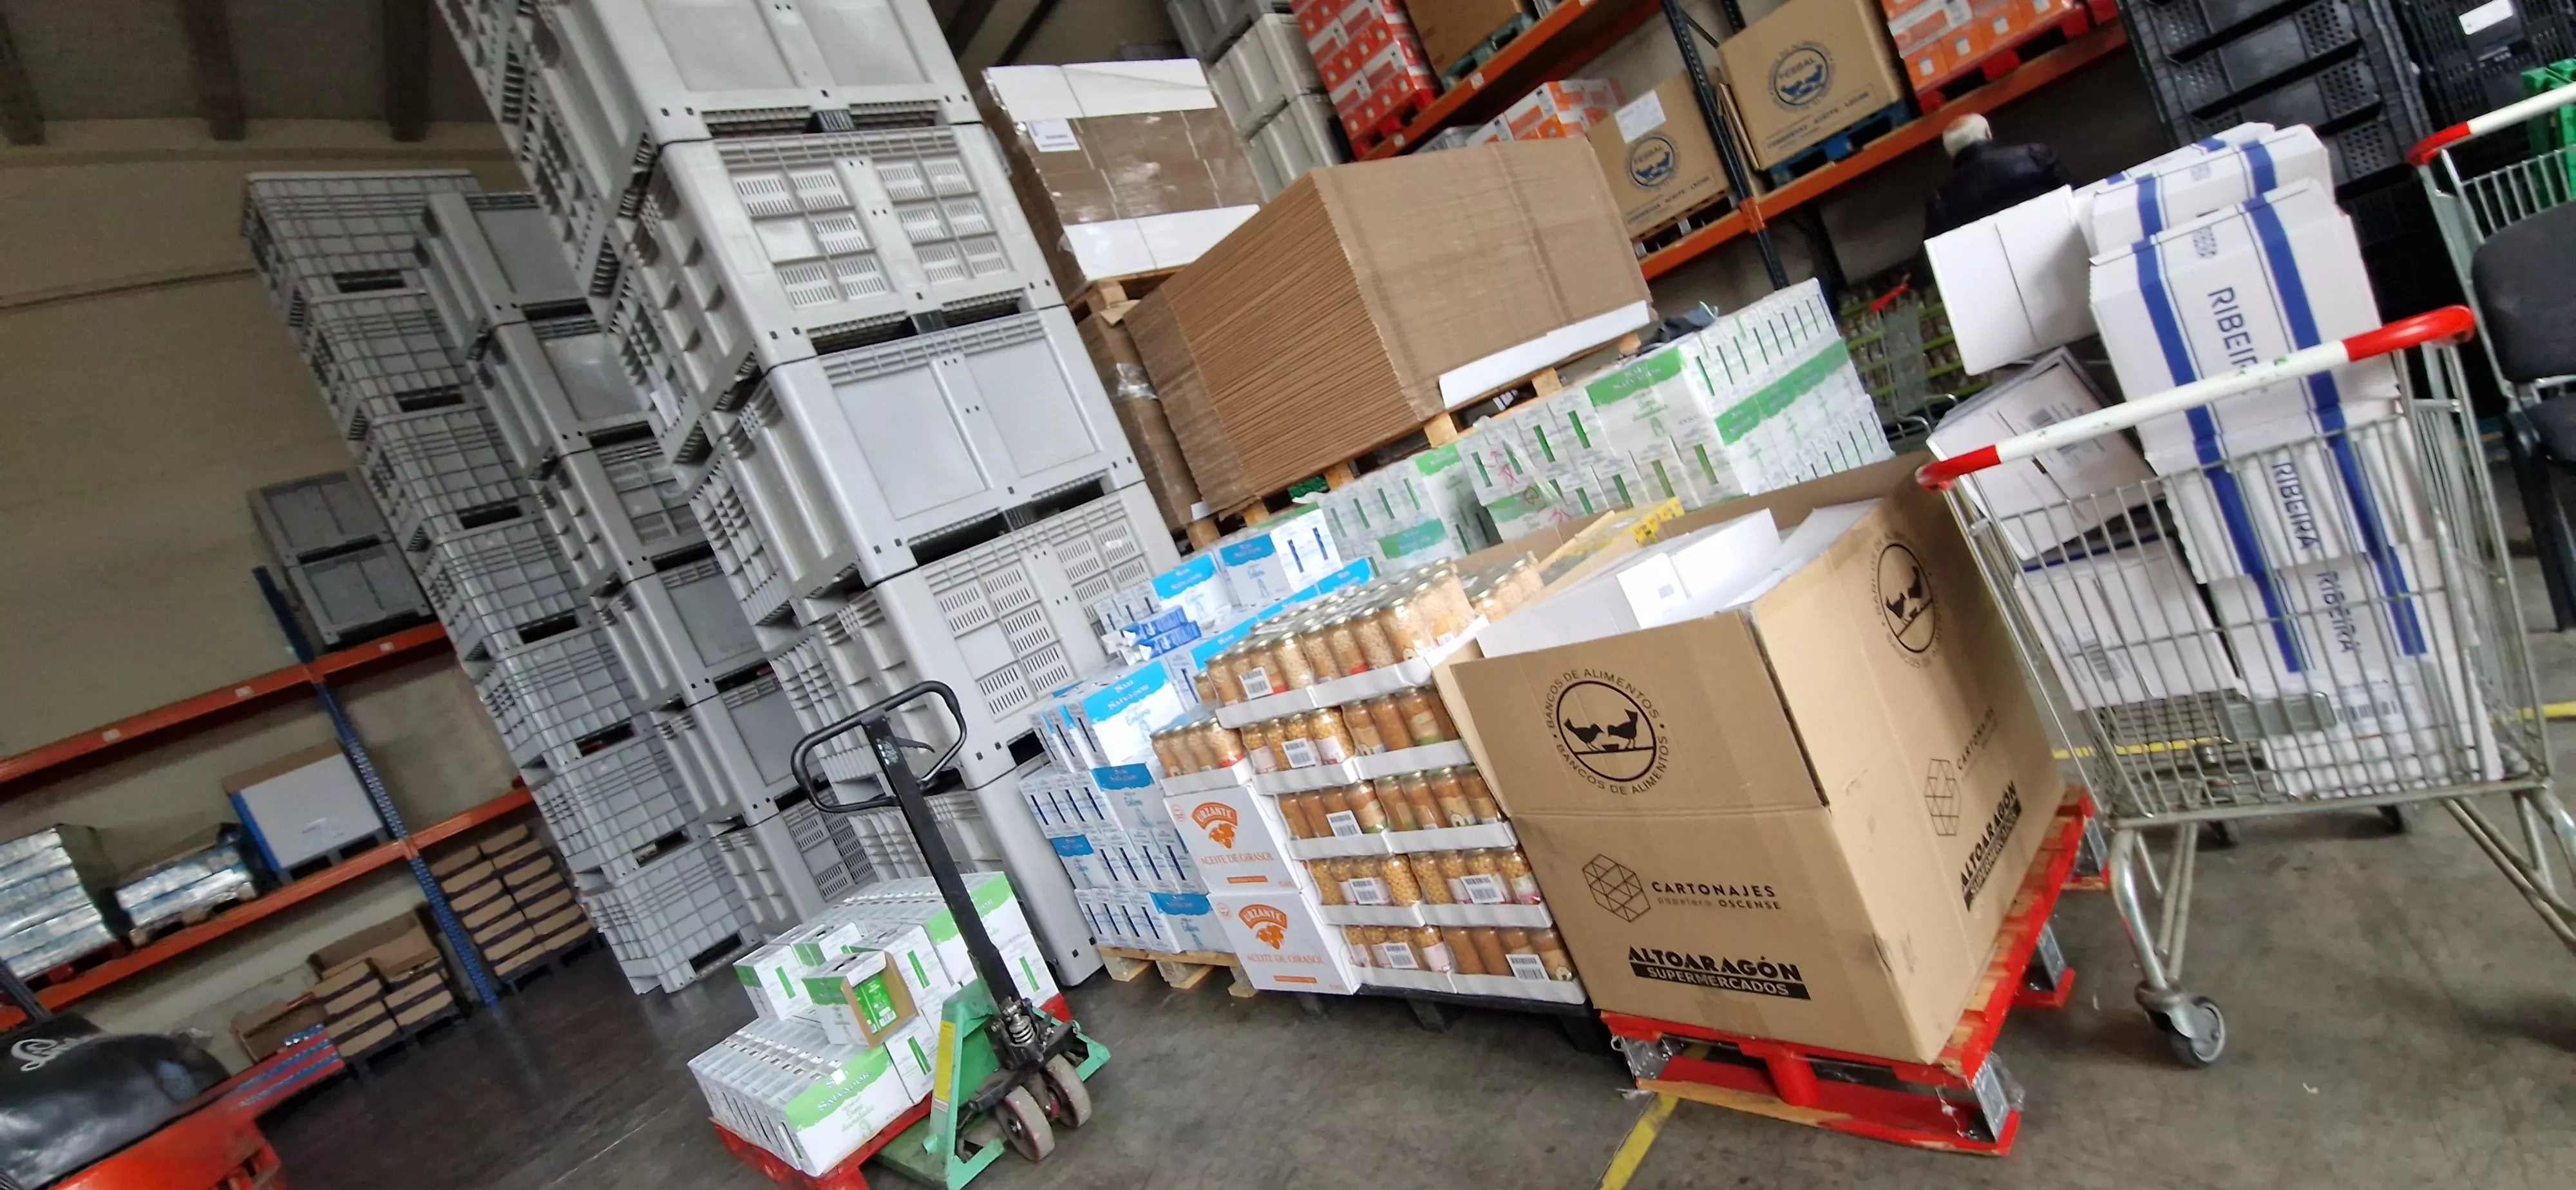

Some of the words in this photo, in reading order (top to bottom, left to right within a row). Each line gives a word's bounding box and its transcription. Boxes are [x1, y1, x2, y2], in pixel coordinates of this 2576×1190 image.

[2272, 462, 2318, 550] RIBEIRA
[1545, 678, 1564, 728] BANCOS
[1563, 670, 1581, 682] DE
[1584, 668, 1660, 719] ALIMENTOS
[1556, 744, 1605, 789] BANCOS
[1610, 784, 1628, 795] DE
[1632, 736, 1669, 795] ALIMENTOS
[1196, 806, 1234, 823] URZANTE
[1201, 855, 1227, 865] ACEITE
[1240, 851, 1275, 863] GIRASOL
[1652, 881, 1777, 898] CARTONAJES
[1718, 898, 1782, 910] OSCENSE
[1244, 909, 1282, 923] URZANTE
[1629, 945, 1803, 981] ALTOARAGÓN
[1647, 967, 1790, 996] SUPERMERCADOS
